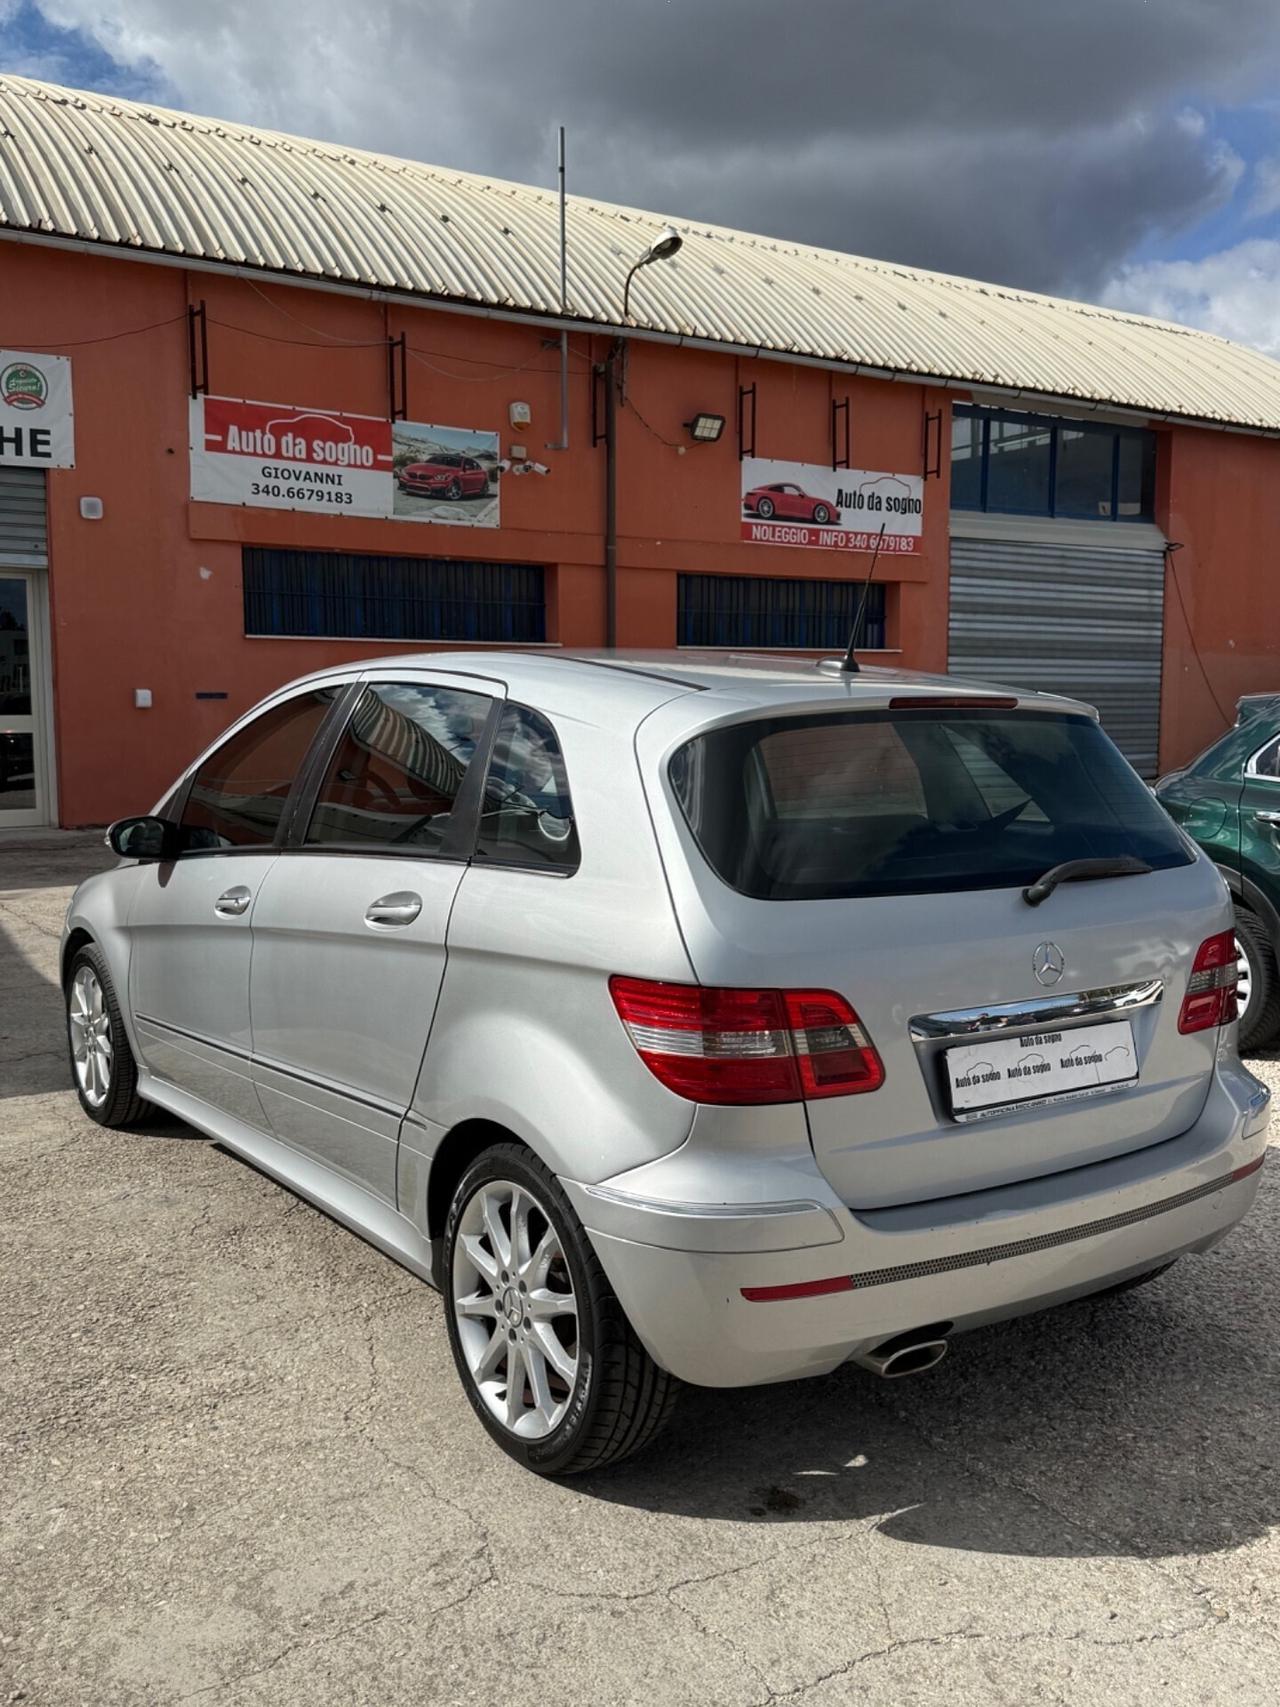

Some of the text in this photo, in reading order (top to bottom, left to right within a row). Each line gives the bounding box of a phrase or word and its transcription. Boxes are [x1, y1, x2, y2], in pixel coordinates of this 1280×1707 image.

[227, 424, 373, 467] Auto da sogno
[261, 466, 343, 486] GIOVANNI
[251, 483, 353, 504] 340.6679183
[835, 488, 922, 515] Auto da sogno
[752, 525, 809, 543] NOLEGGIO
[819, 531, 845, 546] INFO
[848, 534, 868, 548] 340
[1020, 1033, 1062, 1048] Auto da sogno
[1007, 1063, 1051, 1078] Auto da sogno
[1060, 1053, 1102, 1069] Auto da sogno
[956, 1071, 1001, 1088] Auto da sogno
